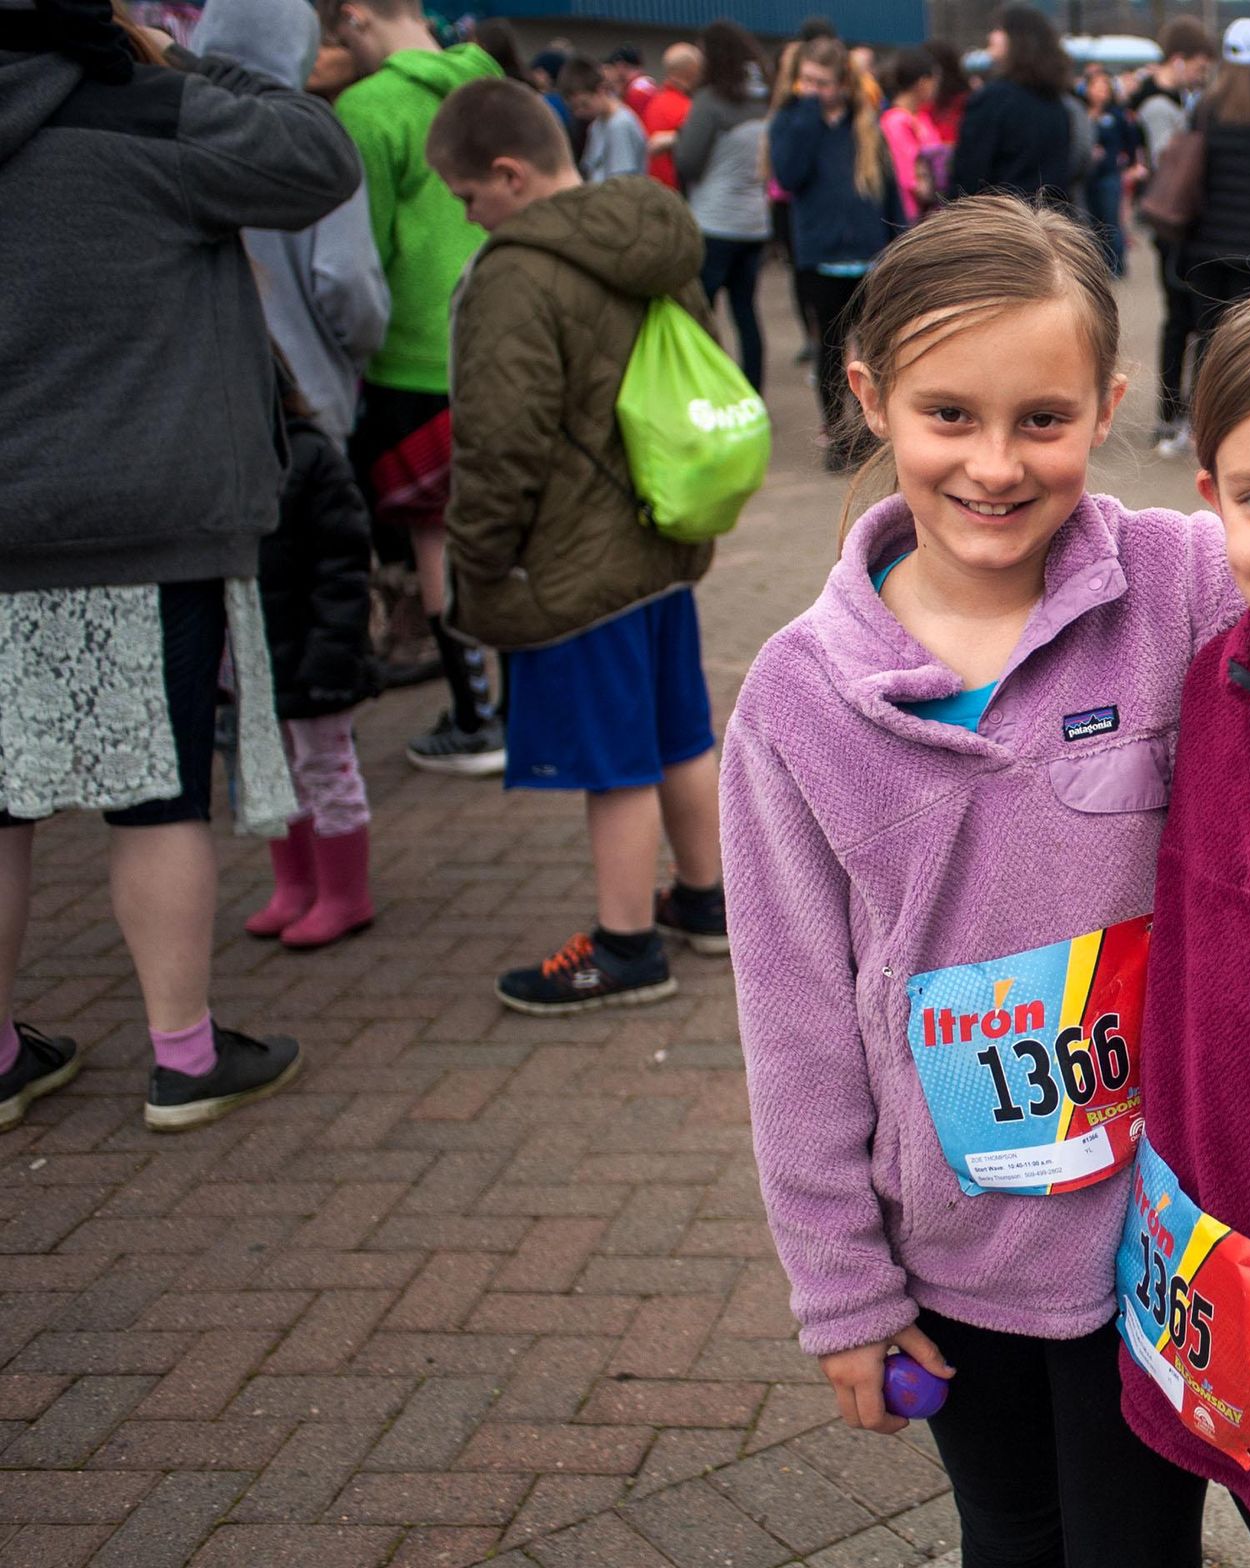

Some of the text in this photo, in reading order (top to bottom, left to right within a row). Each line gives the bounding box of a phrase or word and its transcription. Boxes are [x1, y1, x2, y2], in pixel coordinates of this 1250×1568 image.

[1068, 719, 1113, 738] patagonia
[923, 1000, 1045, 1047] Itron
[977, 1012, 1130, 1123] 1366
[1135, 1231, 1215, 1371] 1365
